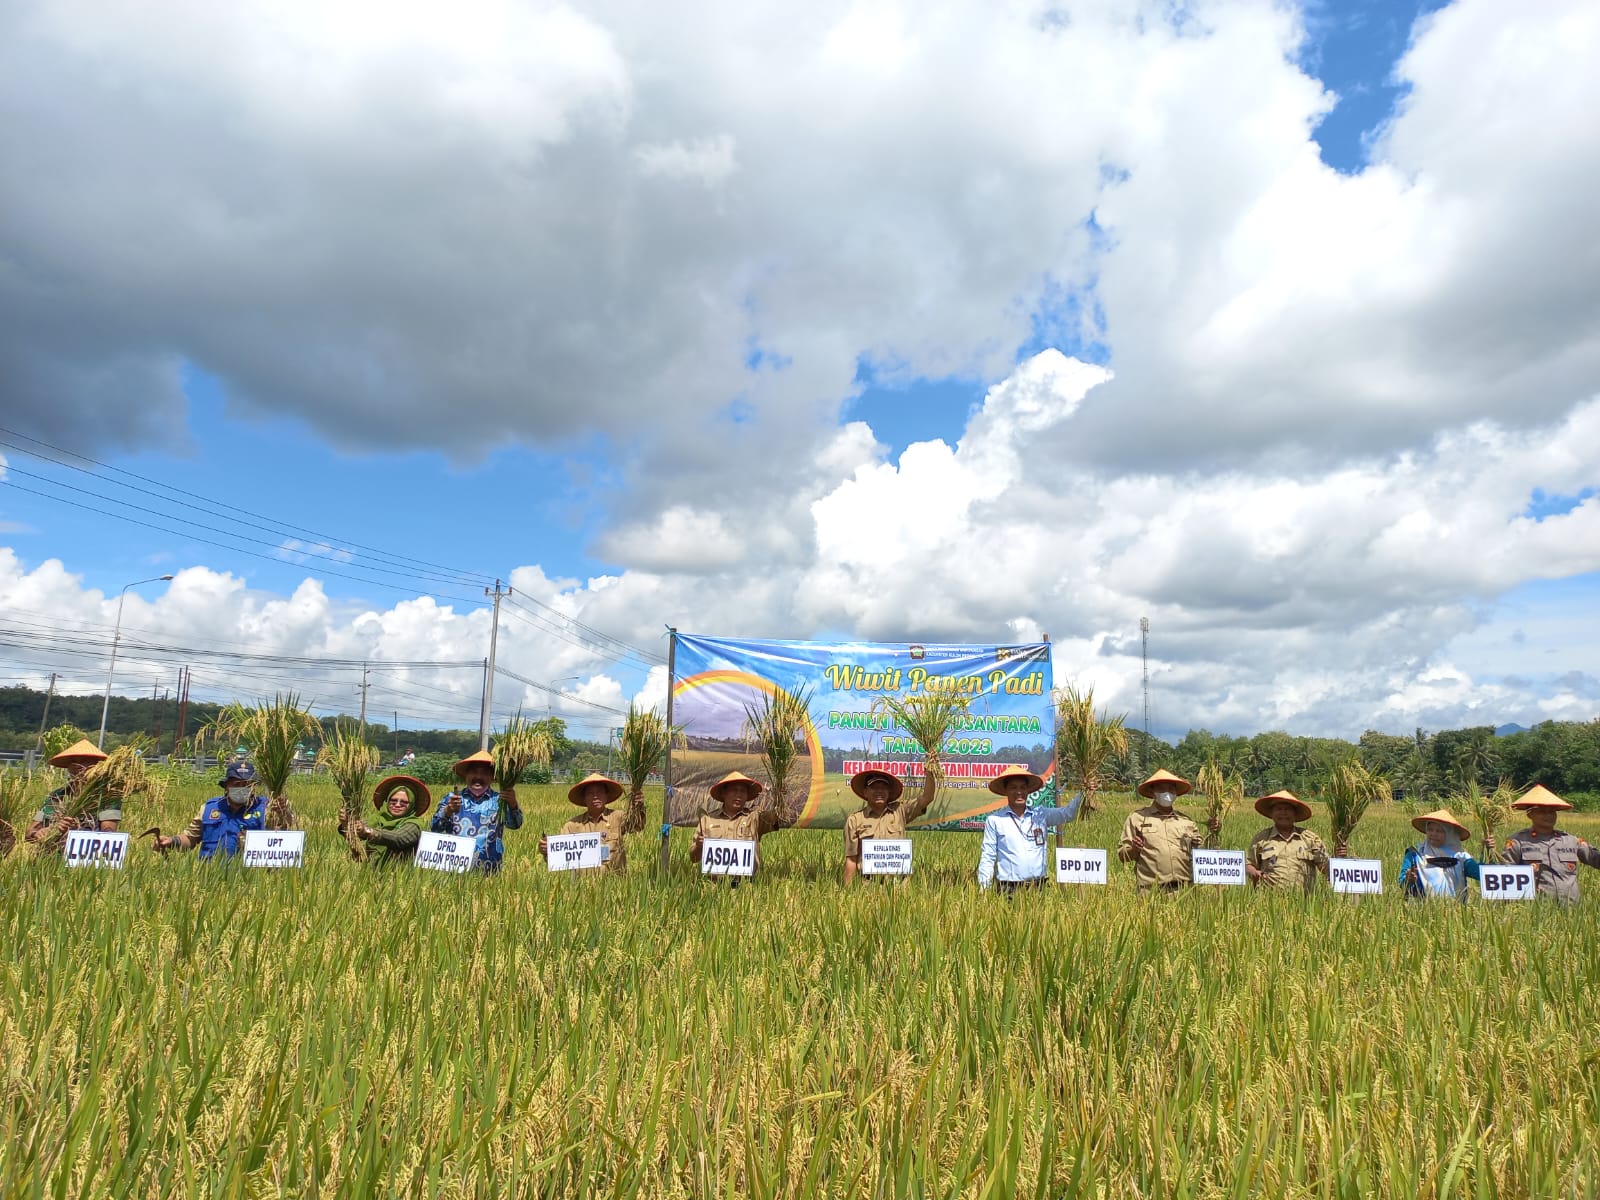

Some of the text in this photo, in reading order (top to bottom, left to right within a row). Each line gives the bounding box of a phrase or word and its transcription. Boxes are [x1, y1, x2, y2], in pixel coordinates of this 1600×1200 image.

[825, 665, 1044, 696] Wiwit Panen Padi
[829, 712, 889, 729] PANEN
[947, 738, 992, 755] 2023
[844, 761, 907, 776] KELOMPOK
[68, 838, 123, 861] LURAH
[267, 838, 283, 847] UPT
[437, 840, 457, 853] DPRD
[550, 838, 598, 852] KEPALA DPKP
[246, 850, 300, 860] PENYULUHAN
[418, 850, 470, 867] KULON PROGO
[565, 851, 582, 862] DIY
[705, 847, 752, 867] ASDA II
[1195, 856, 1243, 866] KEPALA DPUPKP
[1060, 859, 1101, 871] BPD DIY
[1198, 868, 1240, 877] KULON PROGO
[1333, 868, 1378, 884] PANEWU
[1484, 874, 1530, 891] BPP
